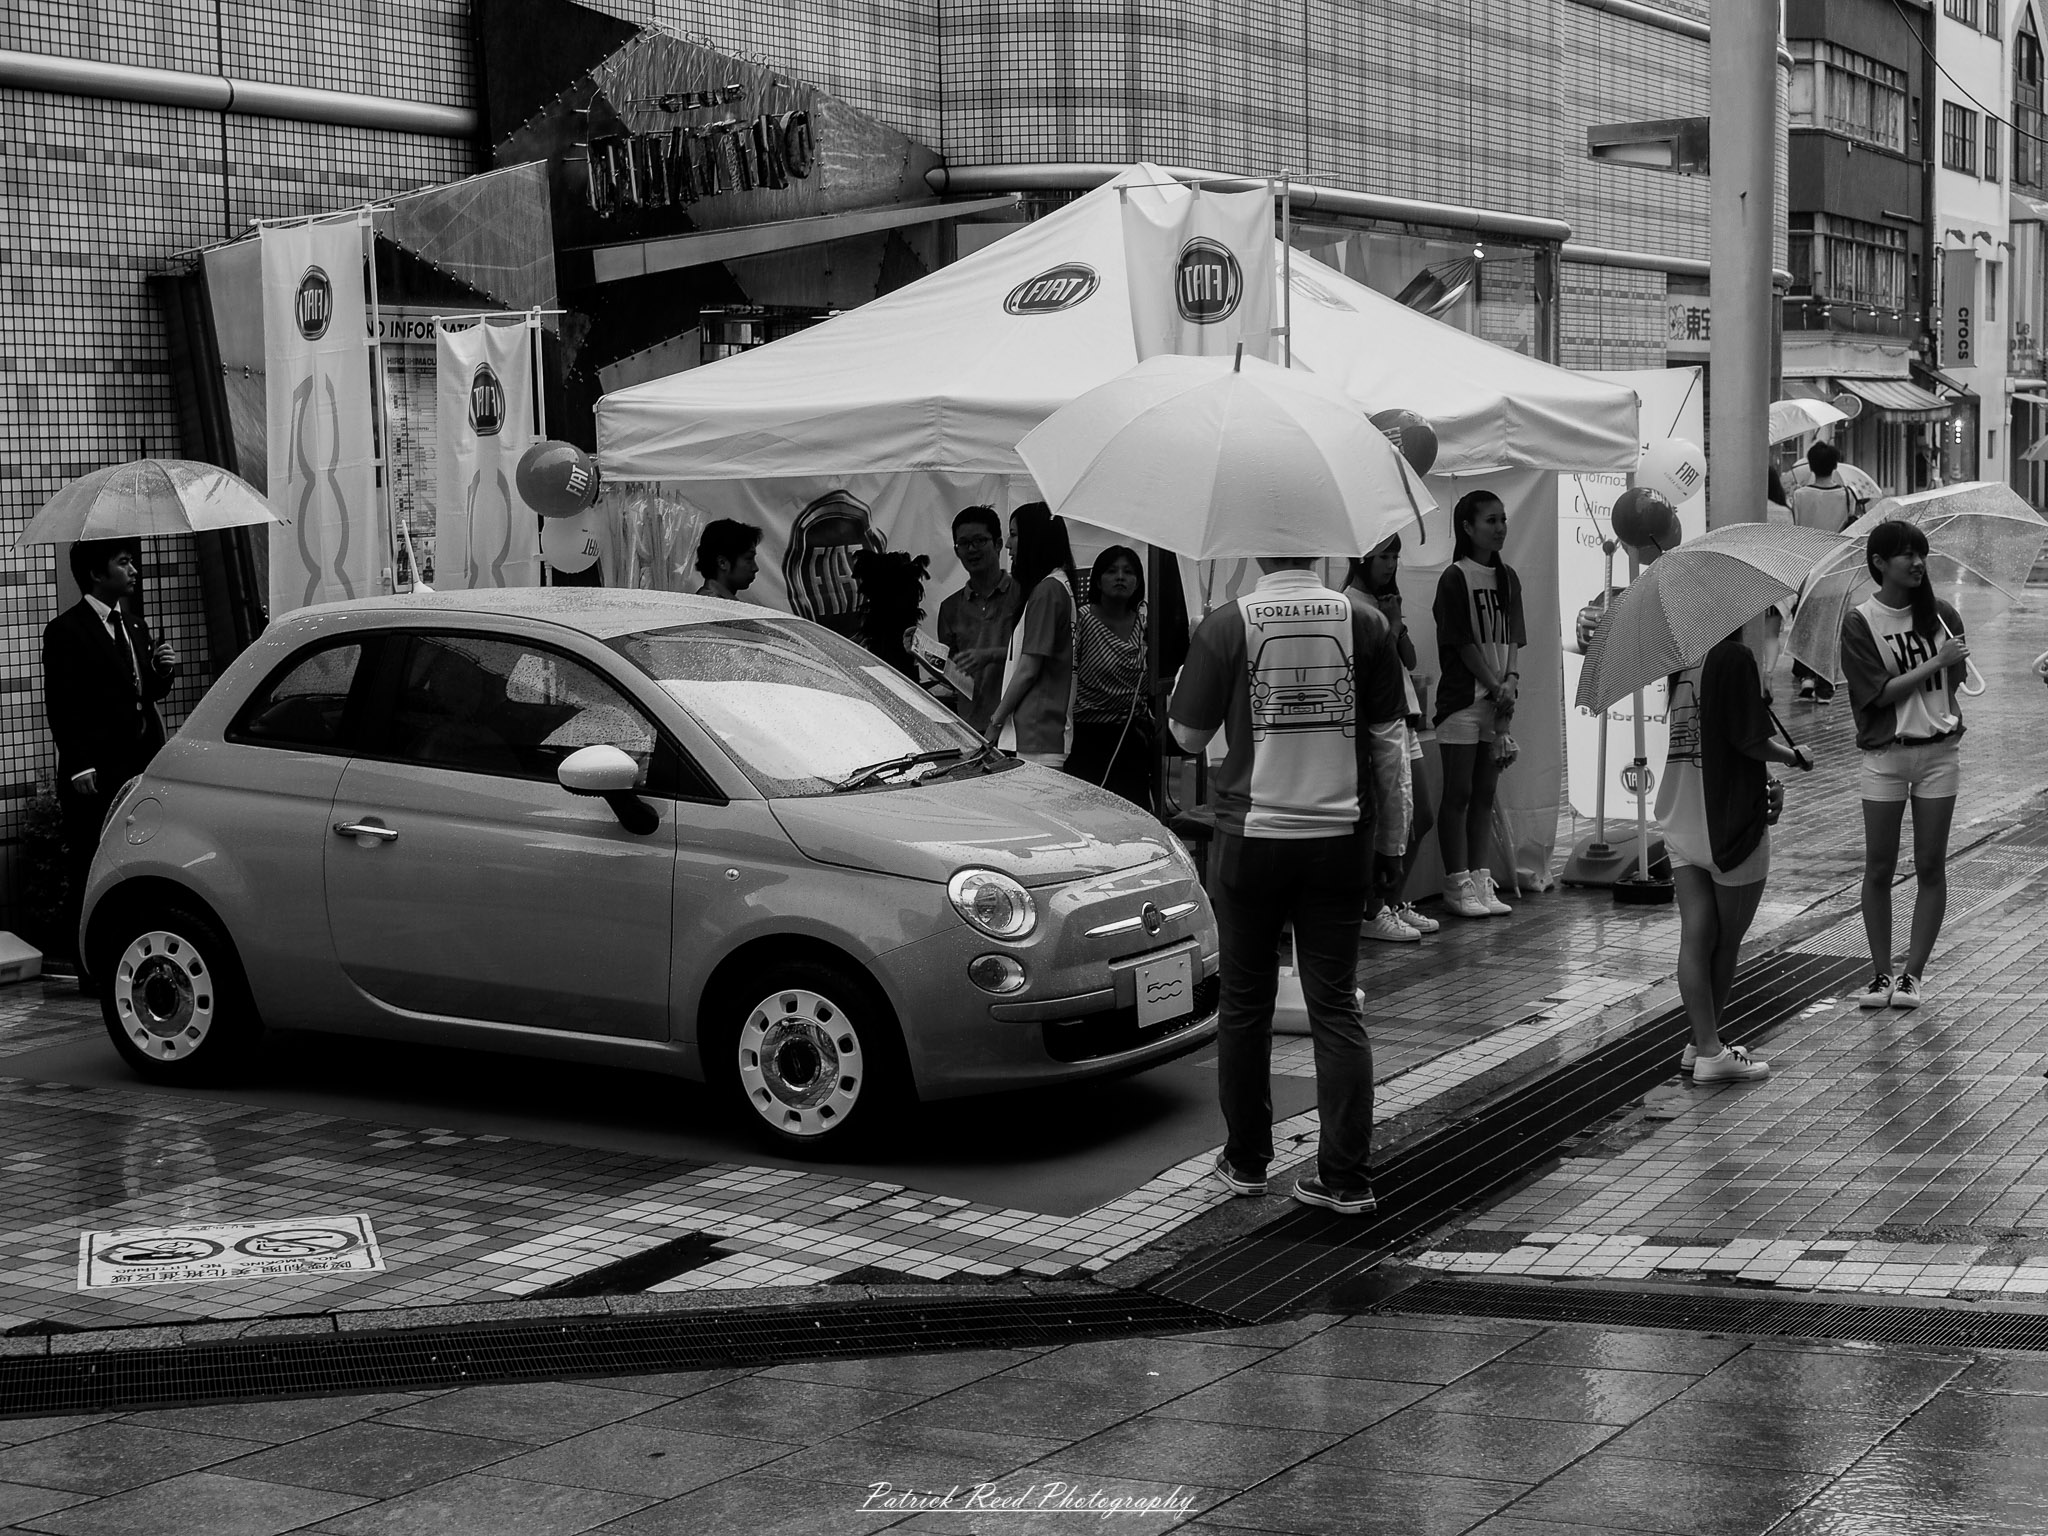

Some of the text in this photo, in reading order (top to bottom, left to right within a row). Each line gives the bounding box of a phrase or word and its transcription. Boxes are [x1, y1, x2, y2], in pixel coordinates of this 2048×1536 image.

[1023, 278, 1083, 304] FIAT
[1958, 307, 1969, 360] crocs
[566, 464, 589, 497] FIAT
[1675, 461, 1700, 487] FIAT
[1255, 605, 1300, 618] FORZA
[1304, 604, 1331, 616] FIAT
